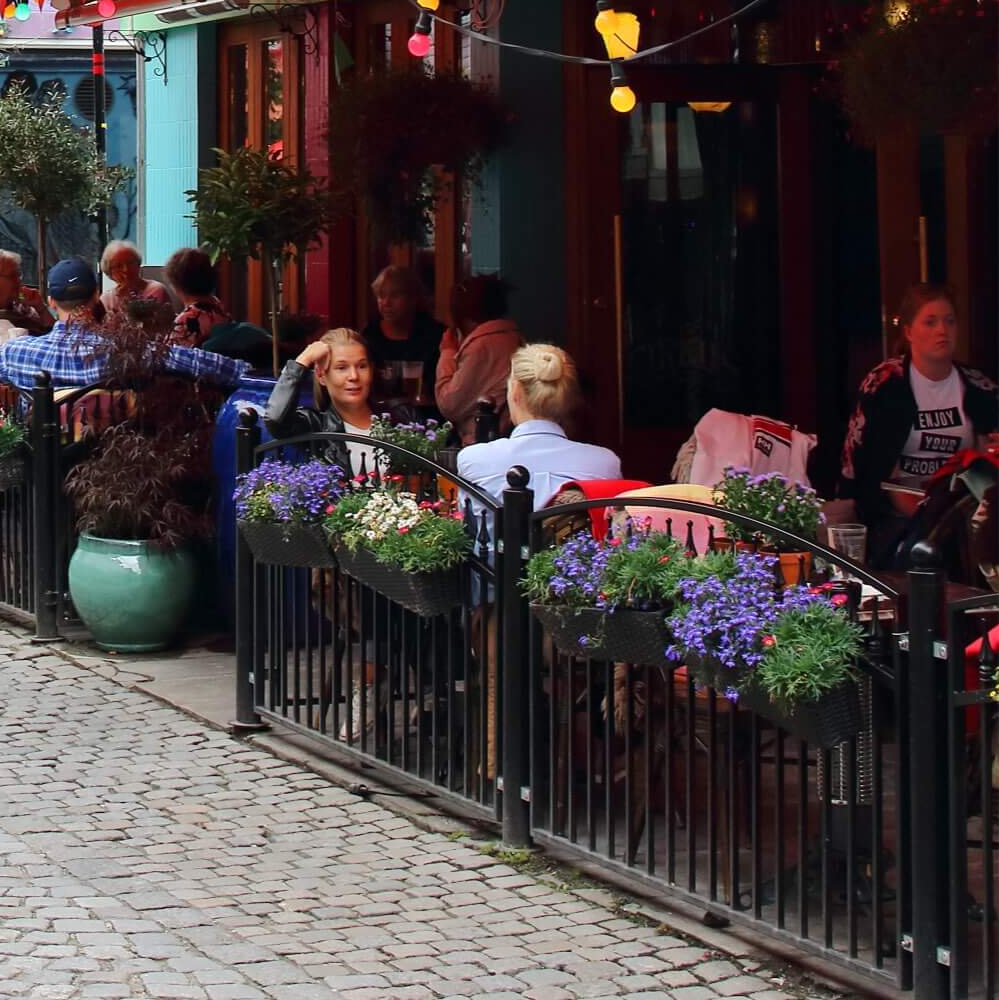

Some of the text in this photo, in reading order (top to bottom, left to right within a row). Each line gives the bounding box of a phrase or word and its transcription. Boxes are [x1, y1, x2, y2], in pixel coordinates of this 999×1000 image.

[918, 409, 956, 429] ENJOY
[925, 435, 958, 452] YOUR
[903, 457, 946, 476] PROBL
